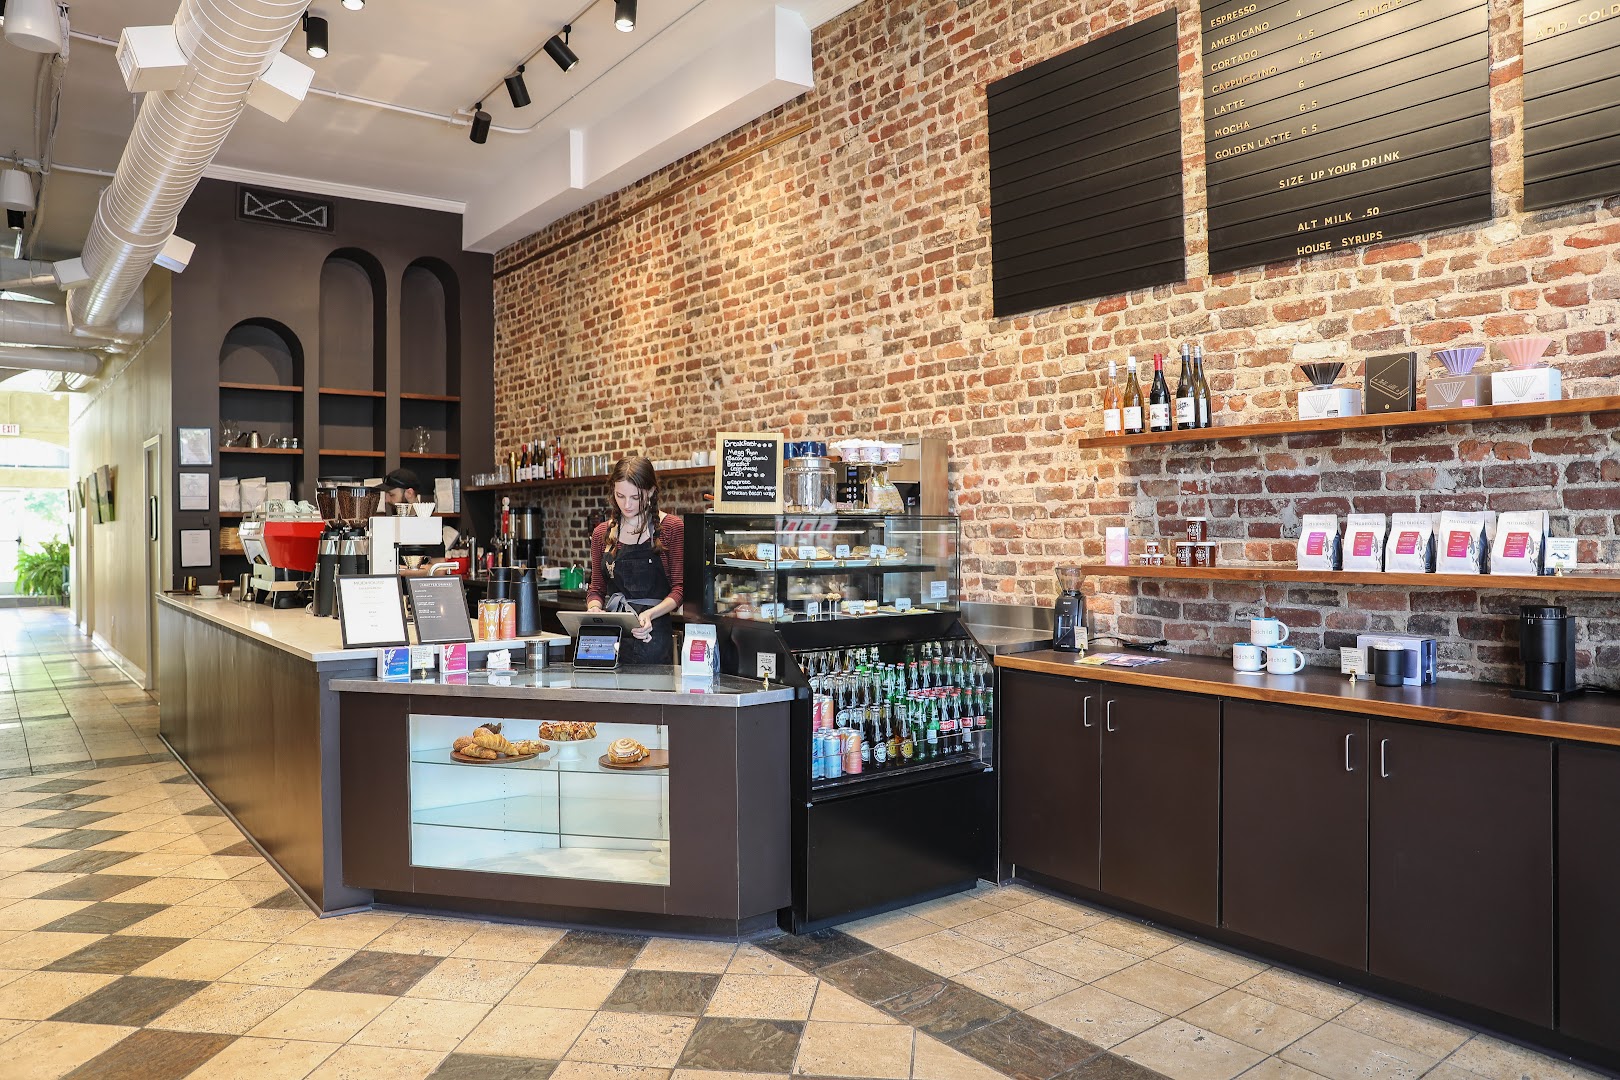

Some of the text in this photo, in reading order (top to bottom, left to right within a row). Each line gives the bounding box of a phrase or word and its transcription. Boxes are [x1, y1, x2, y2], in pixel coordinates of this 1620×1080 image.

[1210, 3, 1257, 28] ESPRESSO
[1210, 9, 1302, 50] AMERICANO 4
[1536, 4, 1620, 39] ADD COLD
[1211, 28, 1315, 72] CORTADO 4.5
[1212, 50, 1322, 94] CAPPUCCINO 4.75
[1213, 79, 1305, 116] LATTE 6
[1214, 100, 1318, 138] MOCHA 6.5
[1215, 142, 1255, 160] GOLDEN
[1257, 131, 1292, 147] LATTE
[1279, 150, 1400, 188] SIZE UP YOUR DRINK
[1297, 219, 1318, 232] ALT
[1324, 212, 1353, 226] MILK
[1297, 231, 1383, 256] HOUSE SYRUPS
[2, 425, 16, 434] EXIT
[723, 470, 745, 478] Lunch
